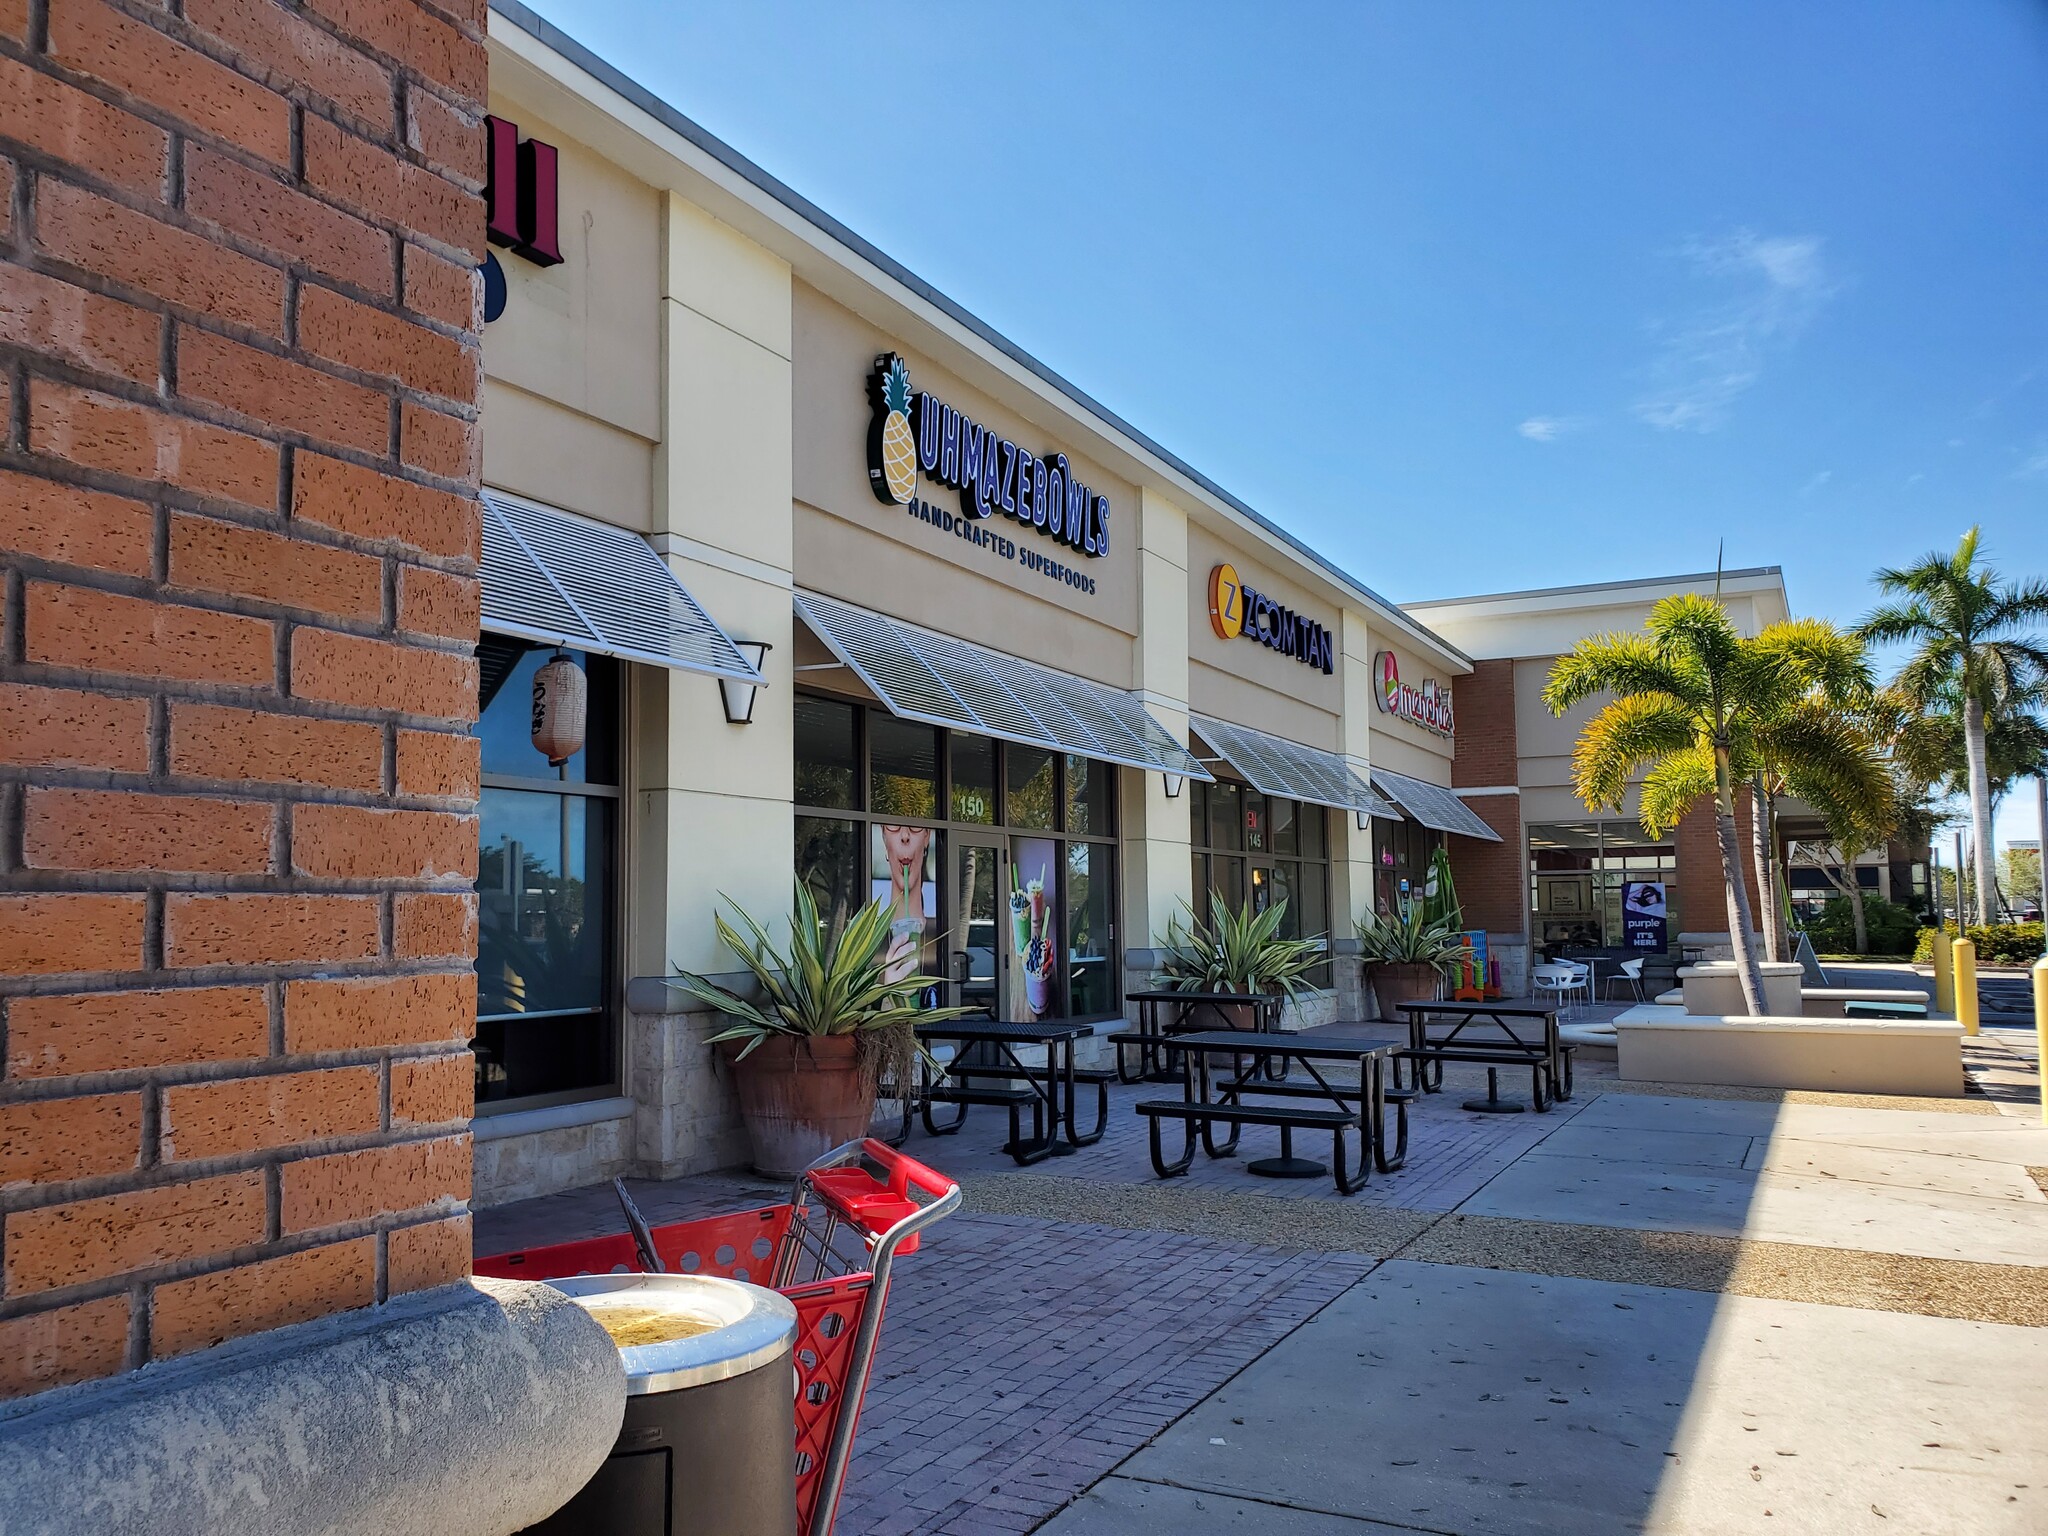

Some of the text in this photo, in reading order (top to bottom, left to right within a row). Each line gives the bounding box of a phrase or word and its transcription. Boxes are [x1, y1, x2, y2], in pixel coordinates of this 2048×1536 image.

[919, 391, 1111, 558] UHMAZEBOWLS
[909, 498, 1096, 596] HANDCRAFTED SUPERFOODS
[960, 796, 984, 817] 150
[1249, 833, 1262, 848] 145
[1628, 918, 1660, 929] purple
